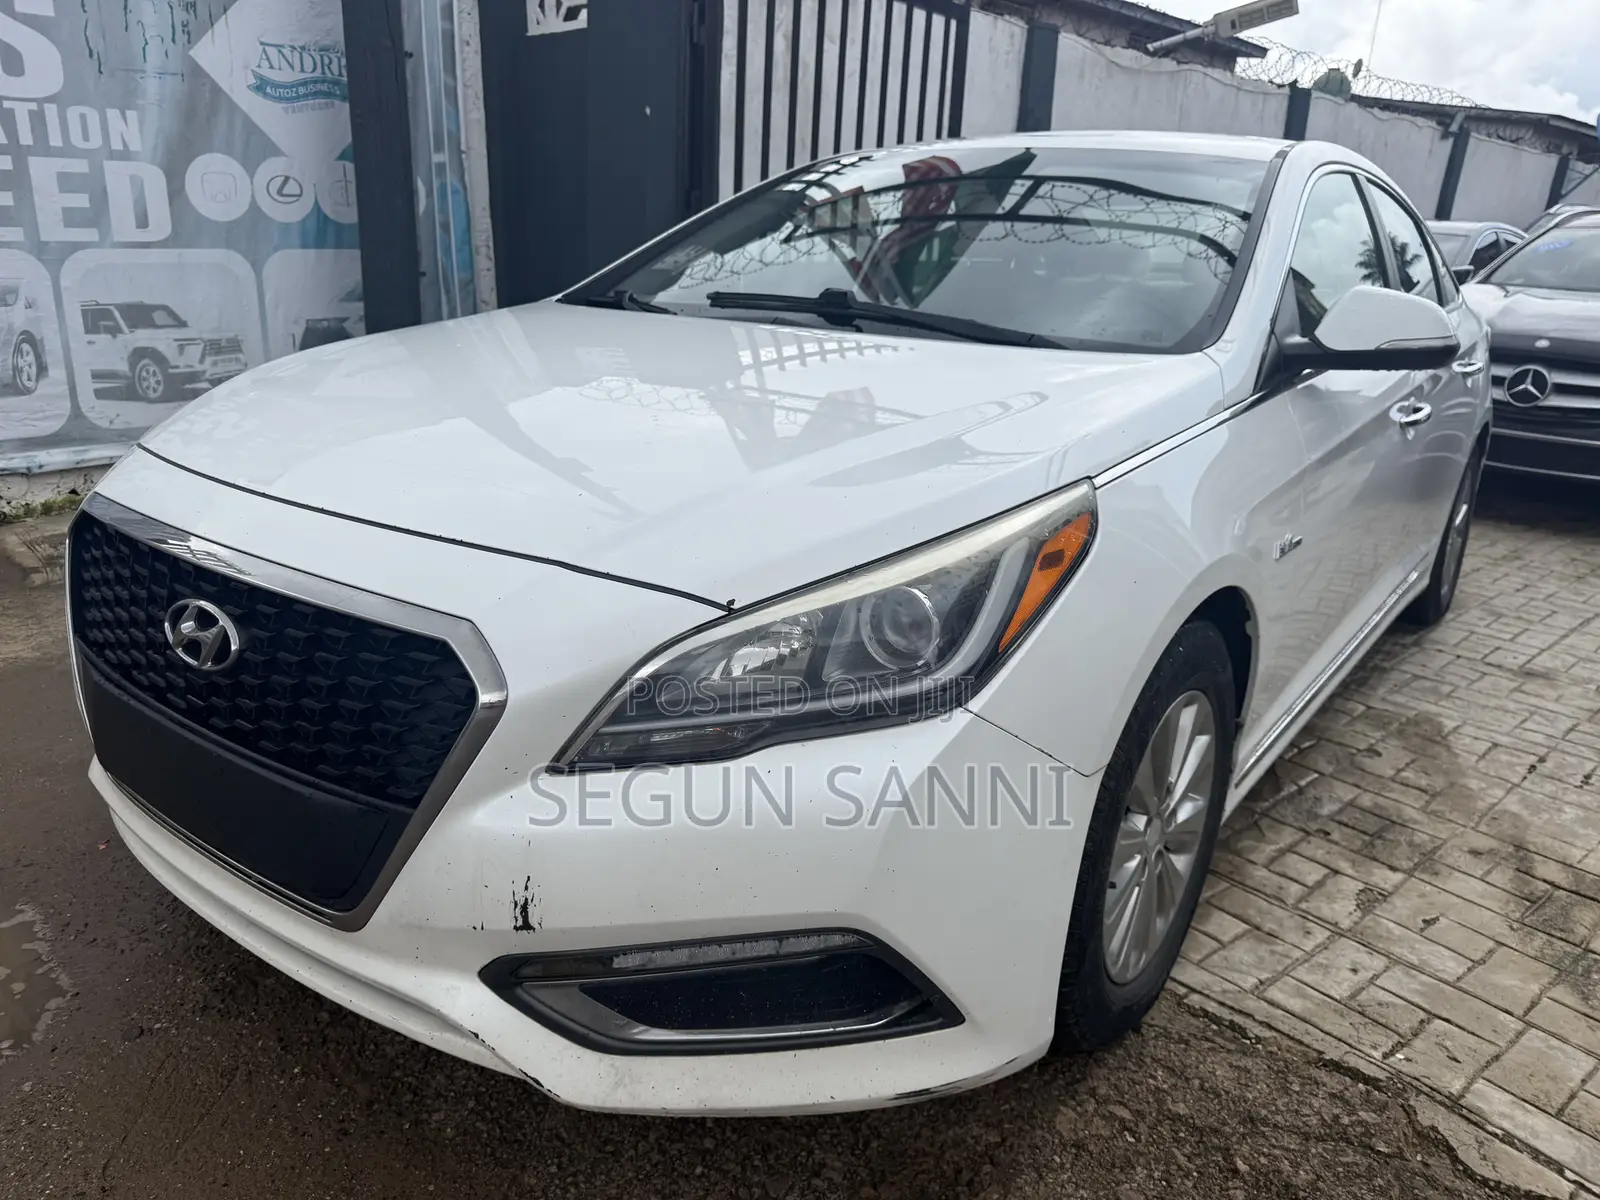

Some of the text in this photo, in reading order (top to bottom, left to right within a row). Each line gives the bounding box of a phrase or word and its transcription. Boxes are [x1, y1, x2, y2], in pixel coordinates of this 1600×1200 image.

[265, 83, 340, 98] AUTOZ BUSINESS
[0, 100, 142, 152] TION
